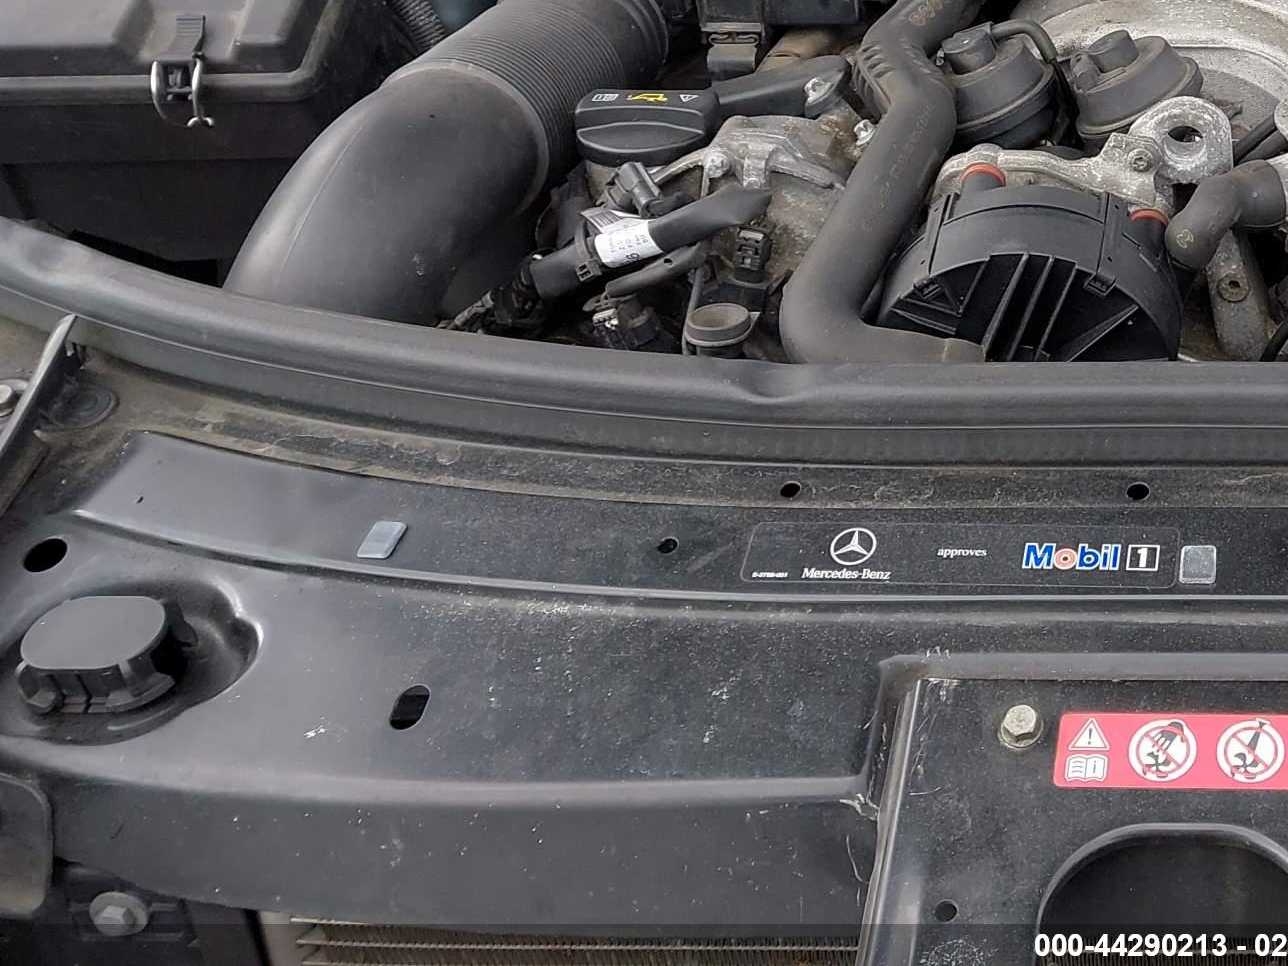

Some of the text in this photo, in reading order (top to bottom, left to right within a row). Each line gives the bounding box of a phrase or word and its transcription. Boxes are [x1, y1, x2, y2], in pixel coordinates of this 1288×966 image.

[937, 547, 987, 559] approves
[1022, 542, 1121, 570] Mobil
[801, 568, 891, 579] Mercedes-Benz
